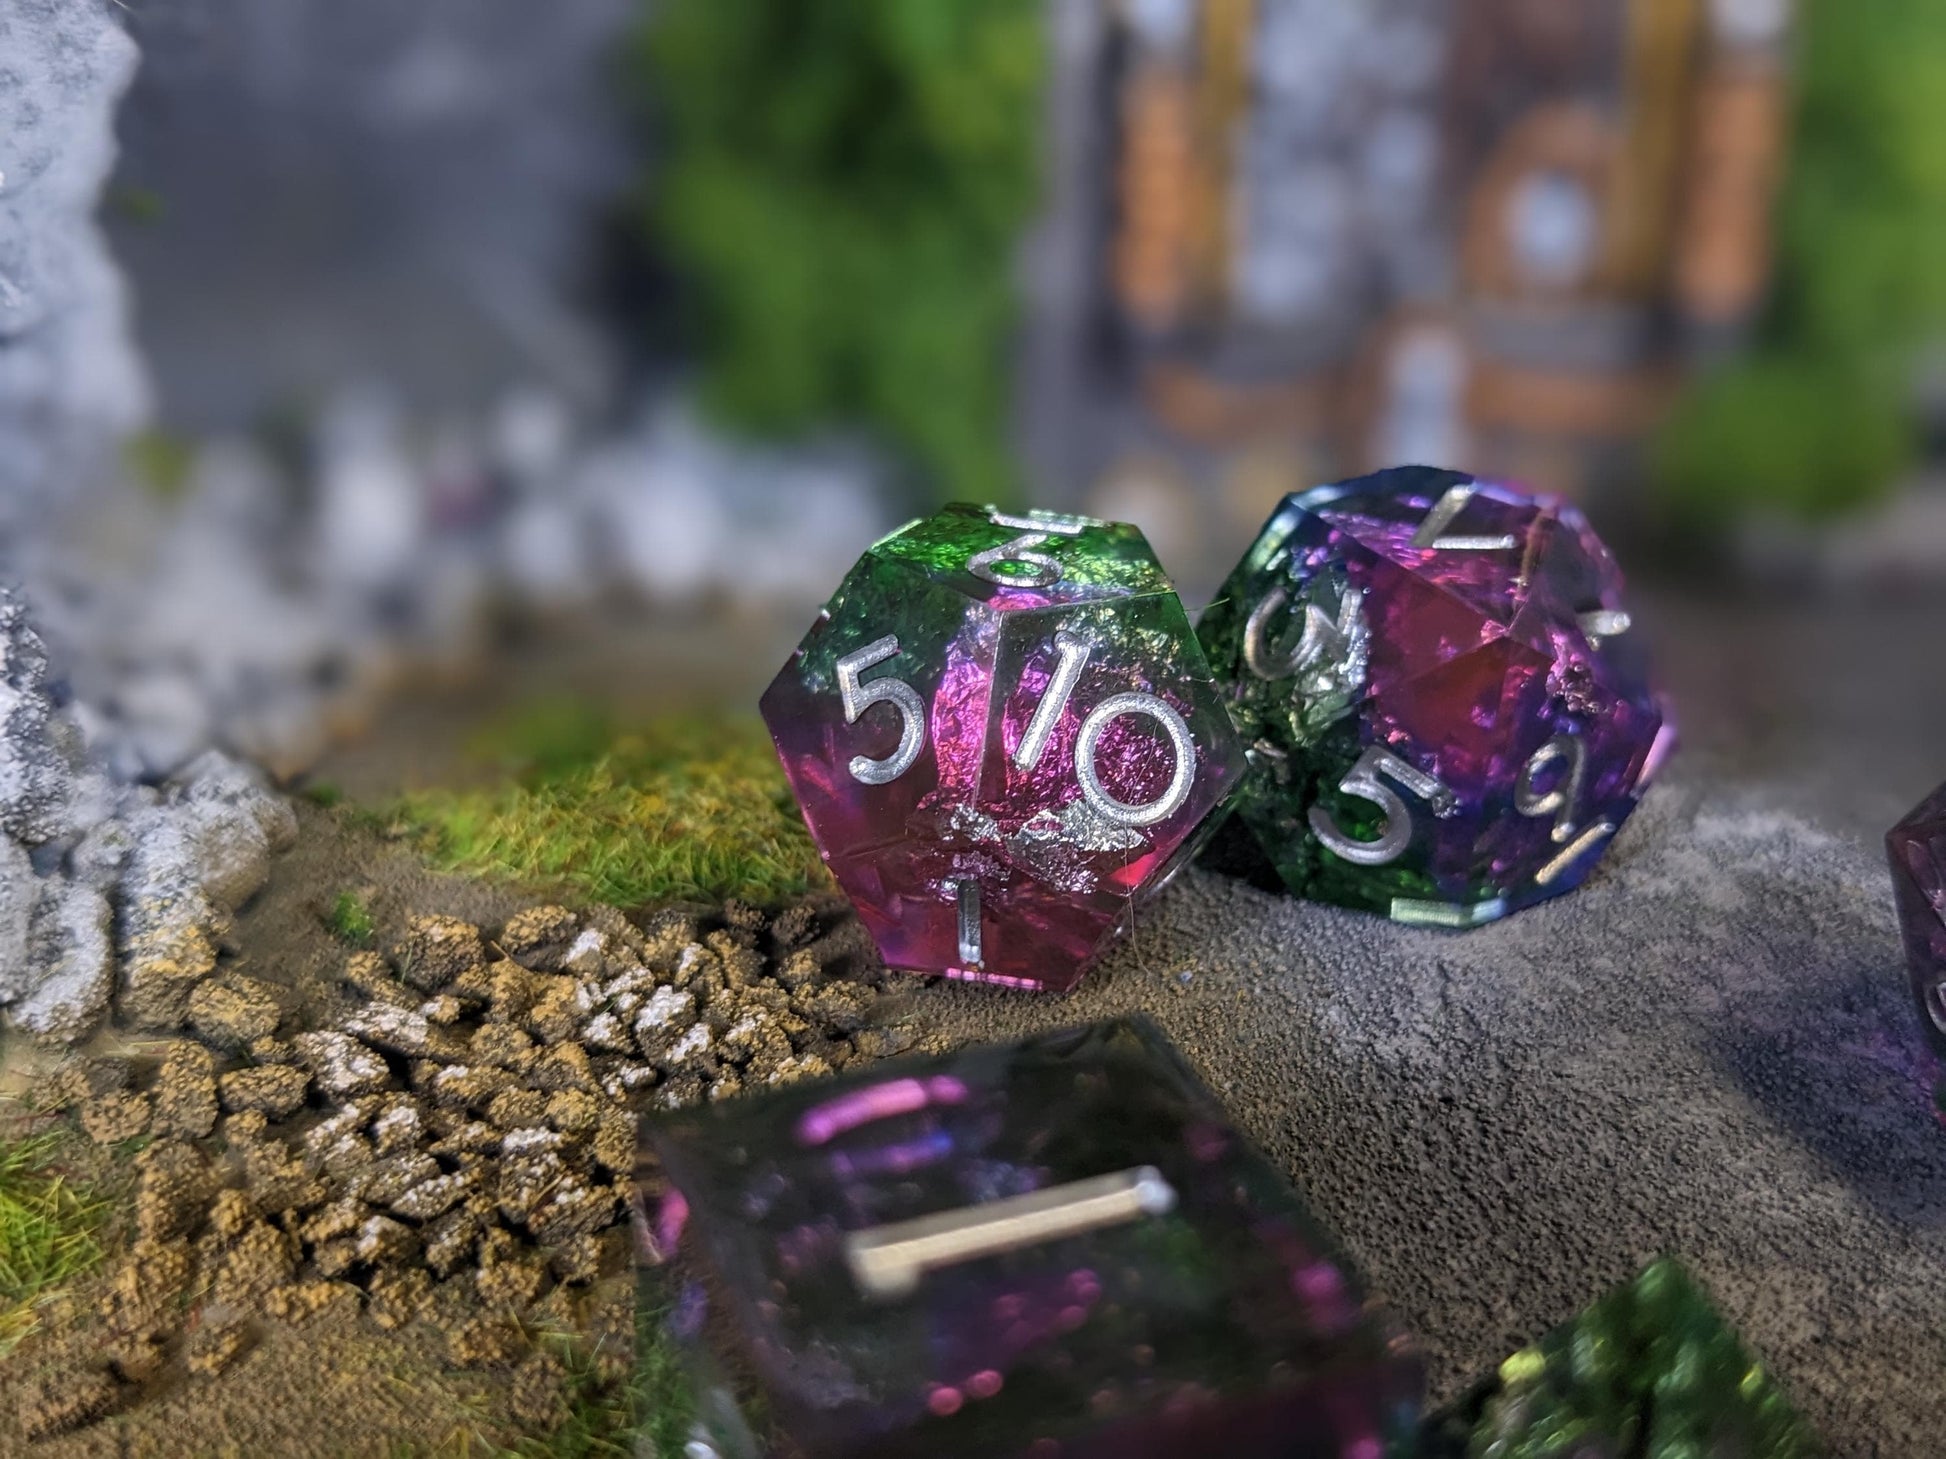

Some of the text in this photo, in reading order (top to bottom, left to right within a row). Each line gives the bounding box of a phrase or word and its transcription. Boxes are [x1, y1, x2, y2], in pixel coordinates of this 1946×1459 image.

[837, 633, 926, 785] 5
[1012, 630, 1197, 827] 10
[1307, 745, 1455, 866] 5
[1515, 733, 1586, 842] 9
